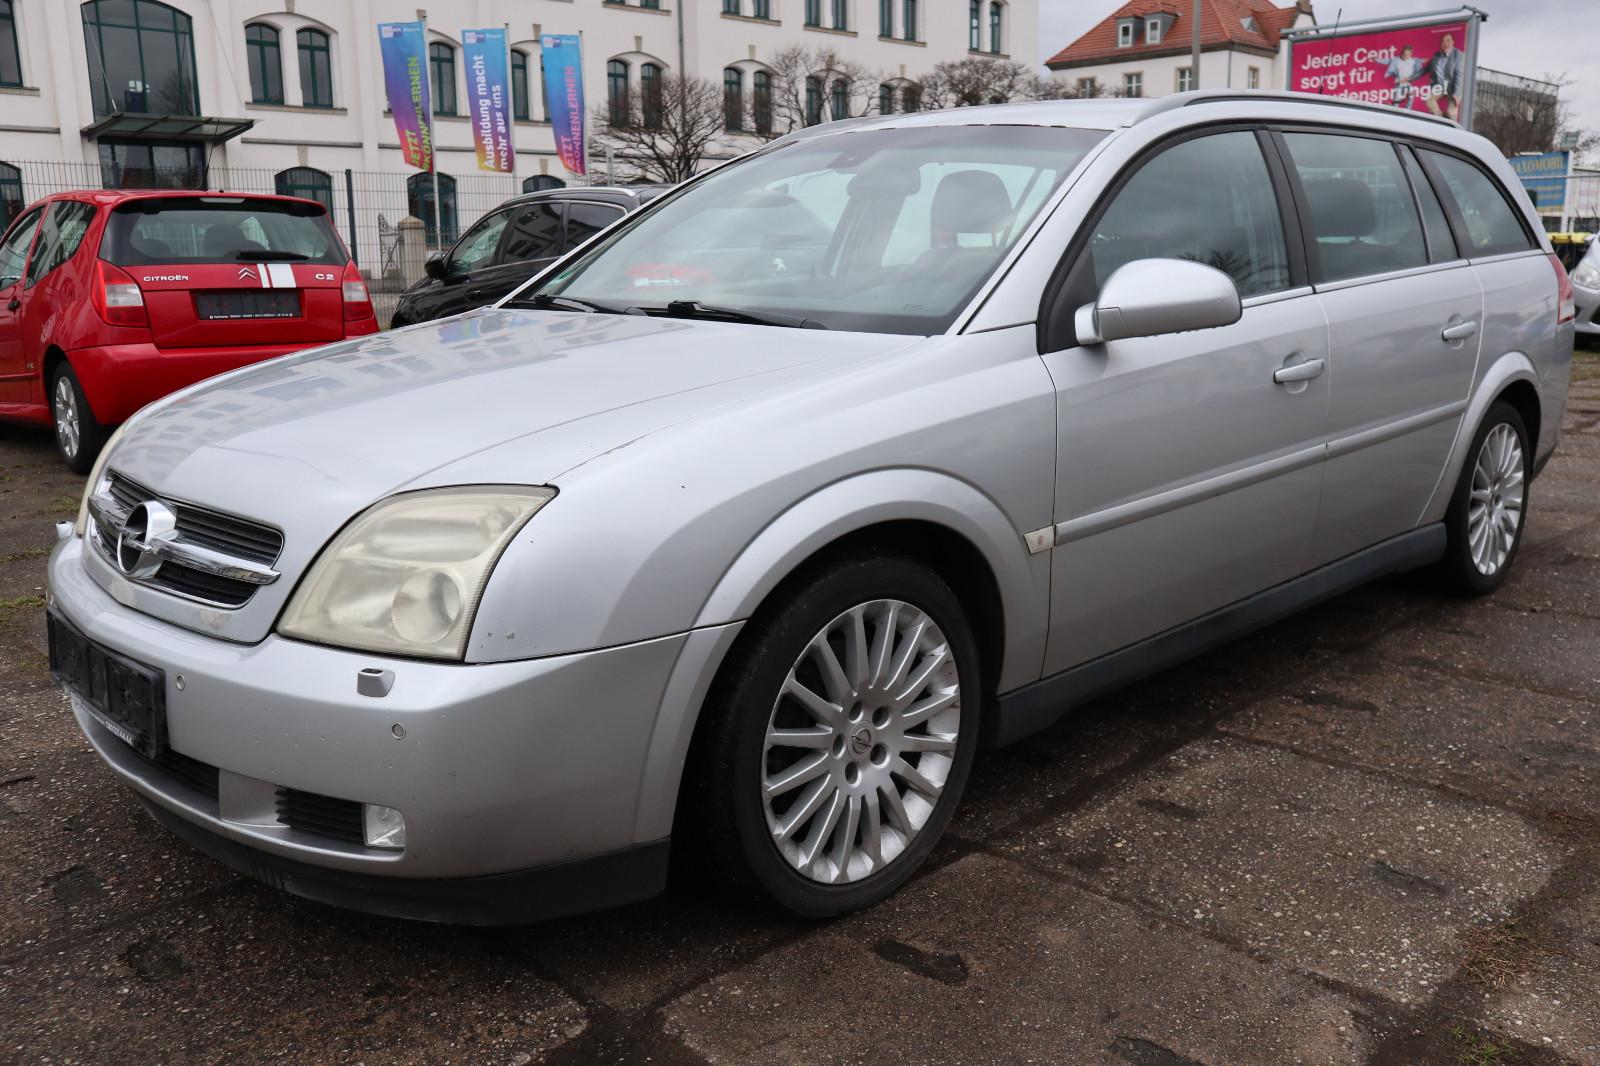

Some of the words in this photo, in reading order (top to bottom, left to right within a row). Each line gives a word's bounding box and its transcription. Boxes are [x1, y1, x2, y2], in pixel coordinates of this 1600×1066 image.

[1301, 52, 1350, 71] Jeder
[1354, 45, 1397, 64] Cent
[472, 54, 488, 96] macht
[1300, 71, 1346, 90] sorgt
[1349, 66, 1375, 84] für
[491, 84, 502, 109] uns
[479, 99, 496, 169] Ausbildung
[494, 111, 506, 134] aus
[405, 129, 421, 167] JETZT
[496, 136, 508, 170] mehr
[143, 274, 189, 282] CITROËN
[314, 272, 336, 281] C2
